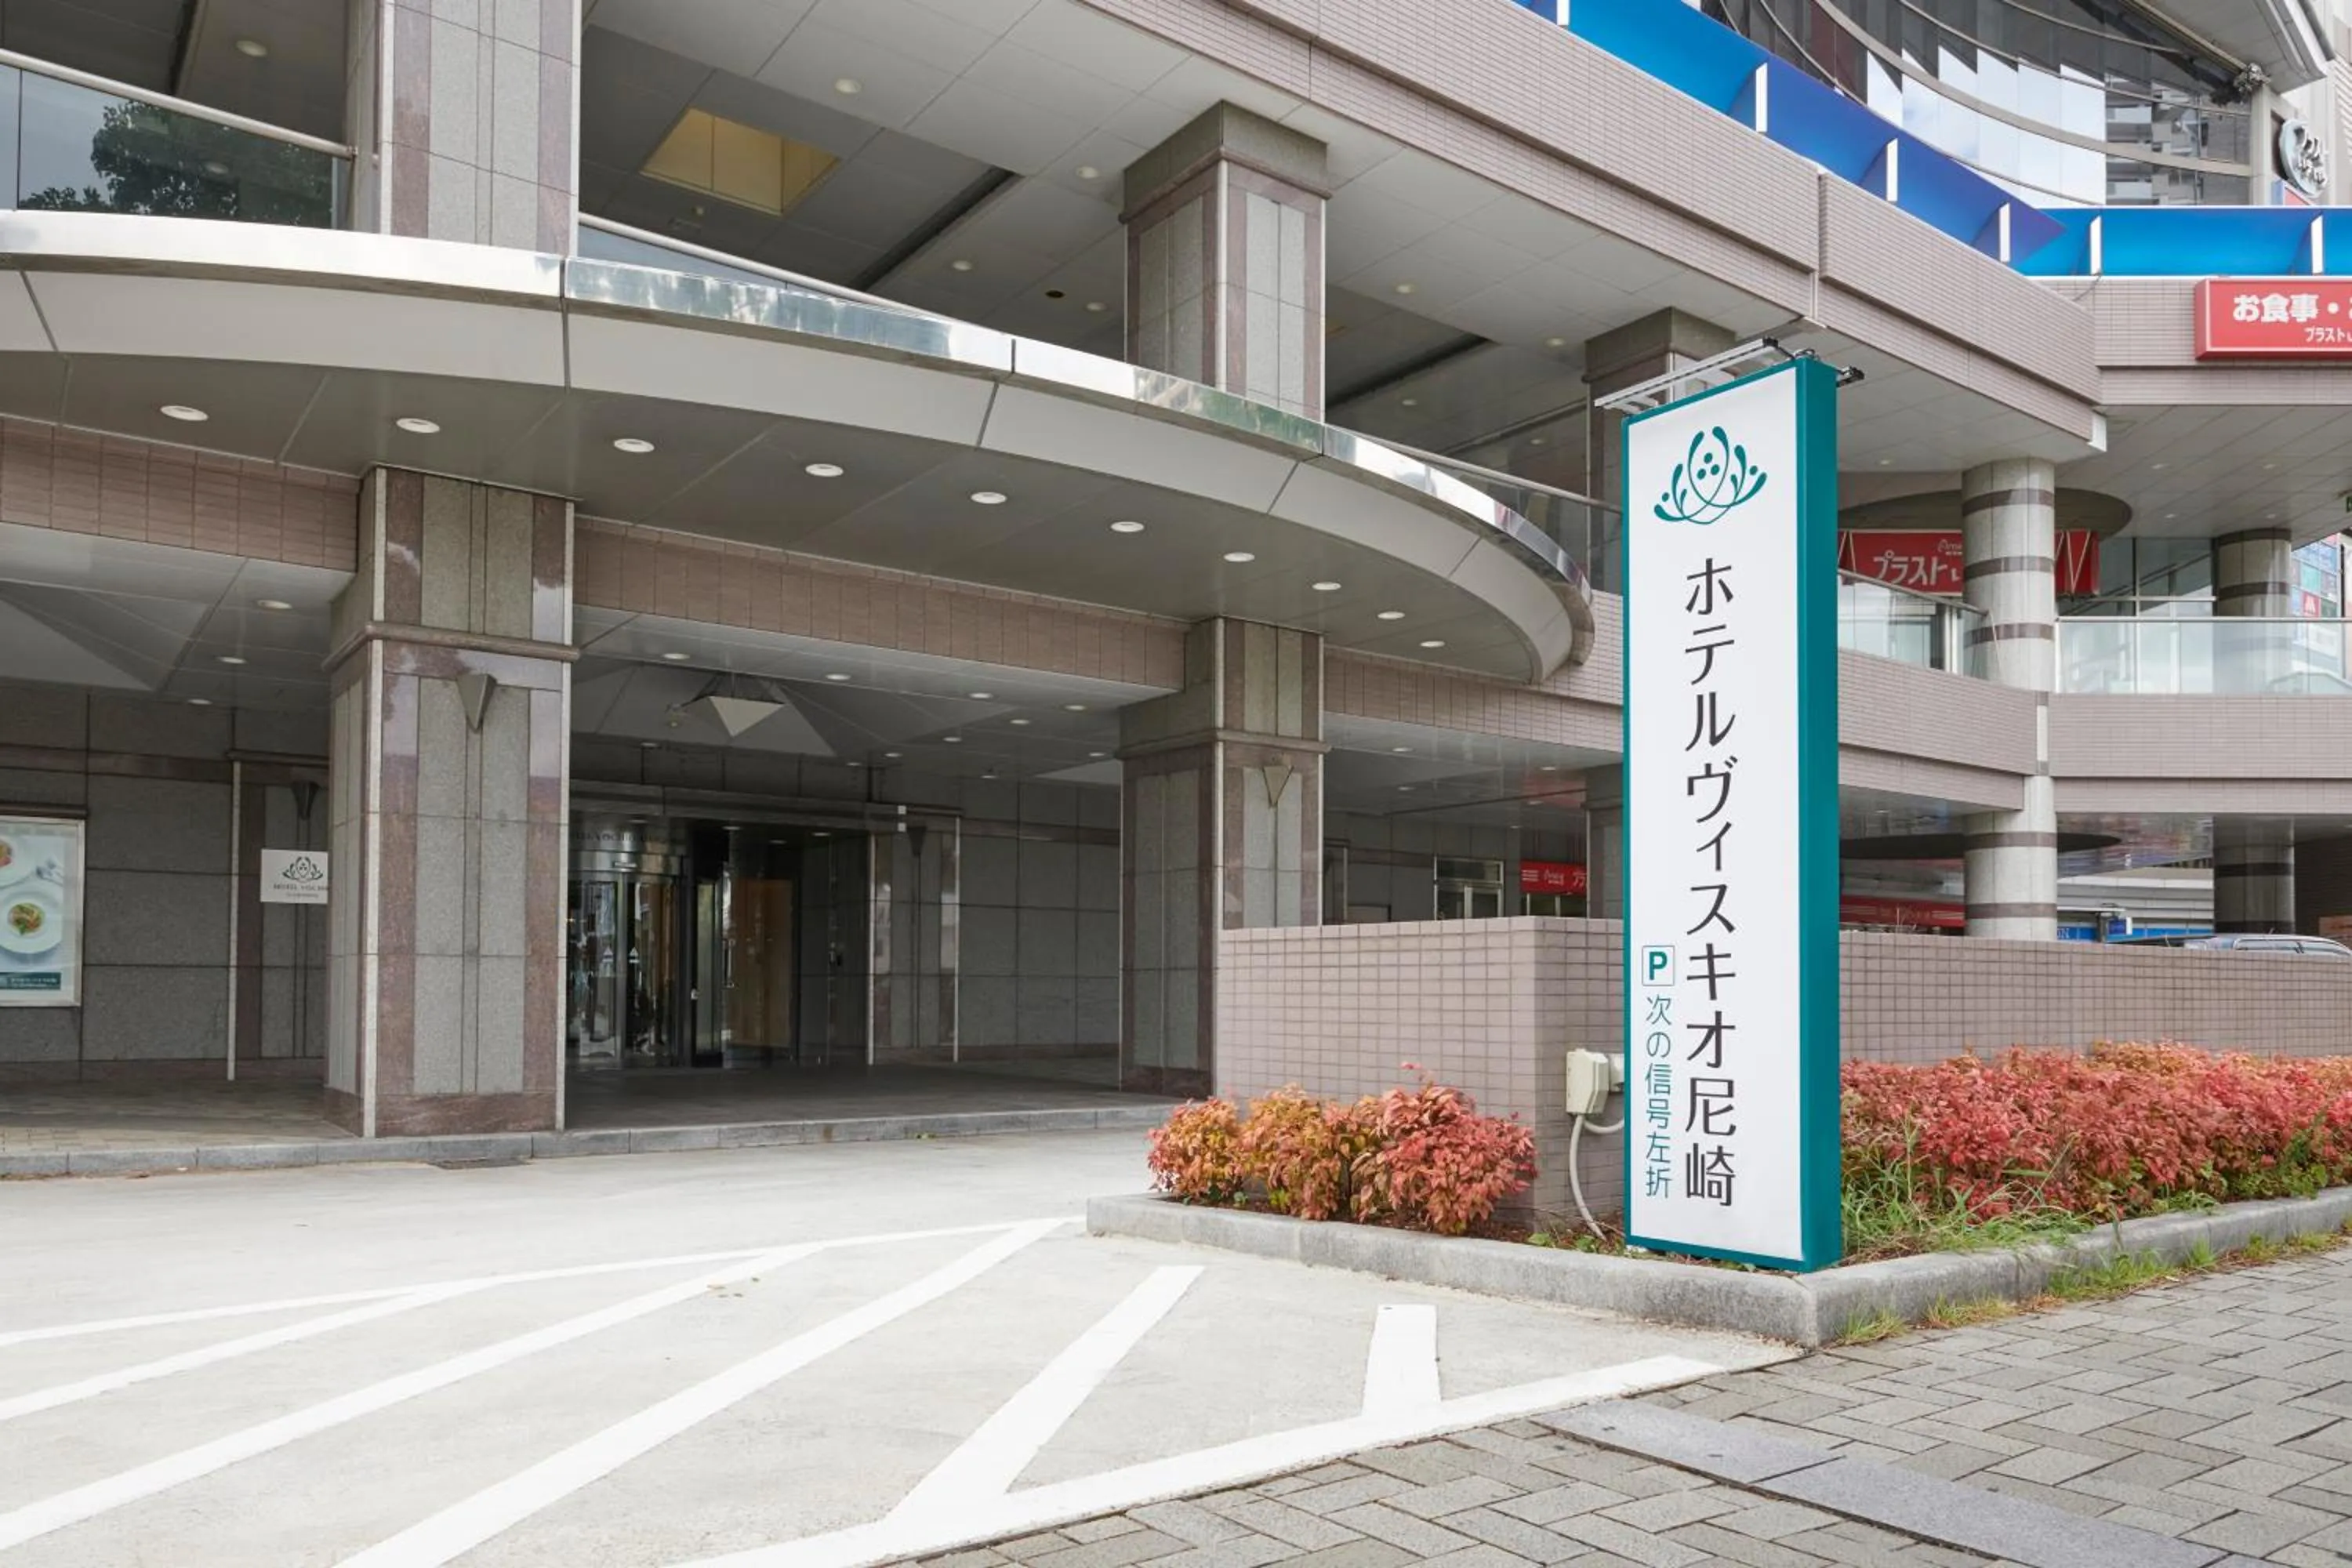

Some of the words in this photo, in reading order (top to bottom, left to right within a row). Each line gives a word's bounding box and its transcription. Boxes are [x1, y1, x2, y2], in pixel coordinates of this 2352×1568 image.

[2233, 293, 2352, 322] お食事・
[1685, 557, 1737, 1207] ホテルヴィスキオ尼崎
[1649, 951, 1668, 980] P
[1645, 994, 1672, 1198] 次の信号左折
